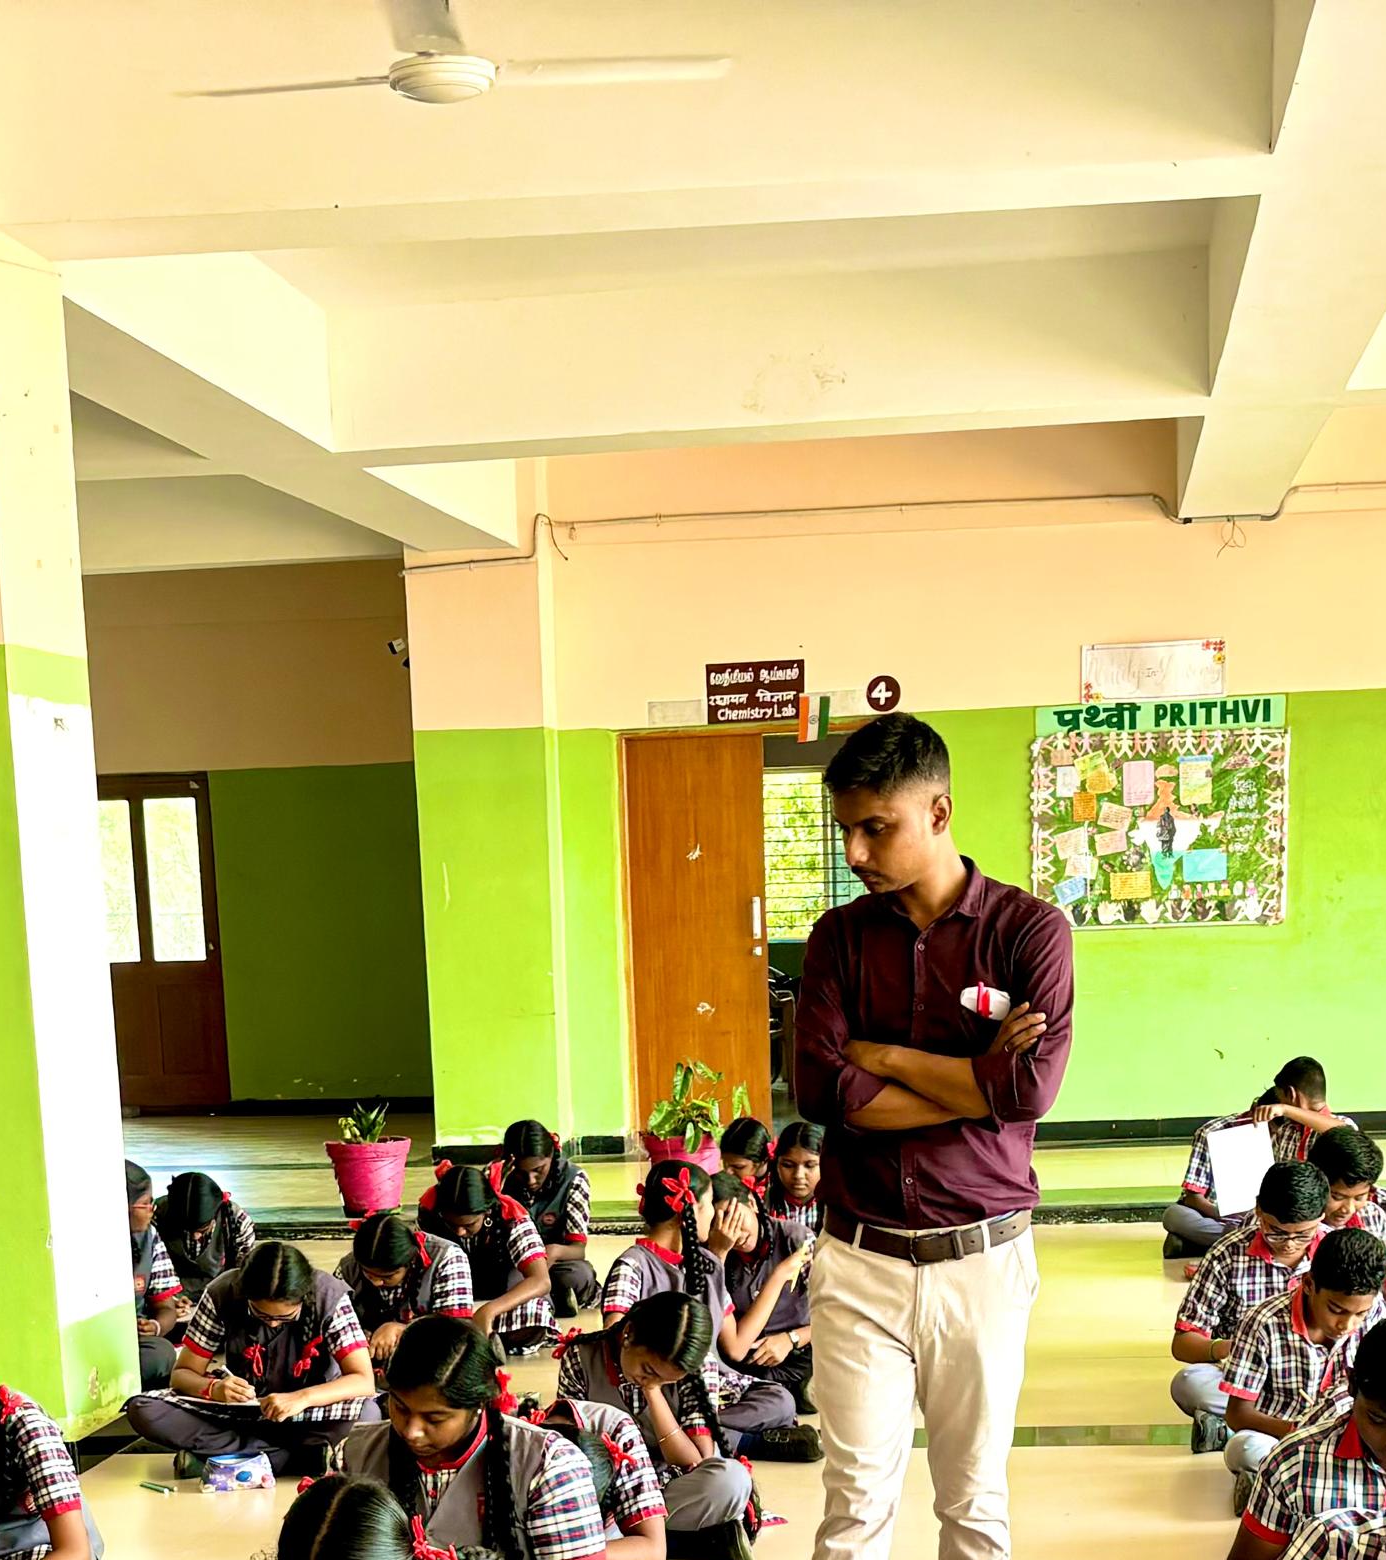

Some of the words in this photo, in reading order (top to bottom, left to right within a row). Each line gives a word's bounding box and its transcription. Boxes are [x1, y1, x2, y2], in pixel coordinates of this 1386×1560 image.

[871, 681, 892, 705] 4
[717, 706, 772, 720] Chemistry
[774, 703, 796, 718] Lab
[1053, 702, 1141, 734] पृथ्वी
[1154, 699, 1271, 727] PRITHVI
